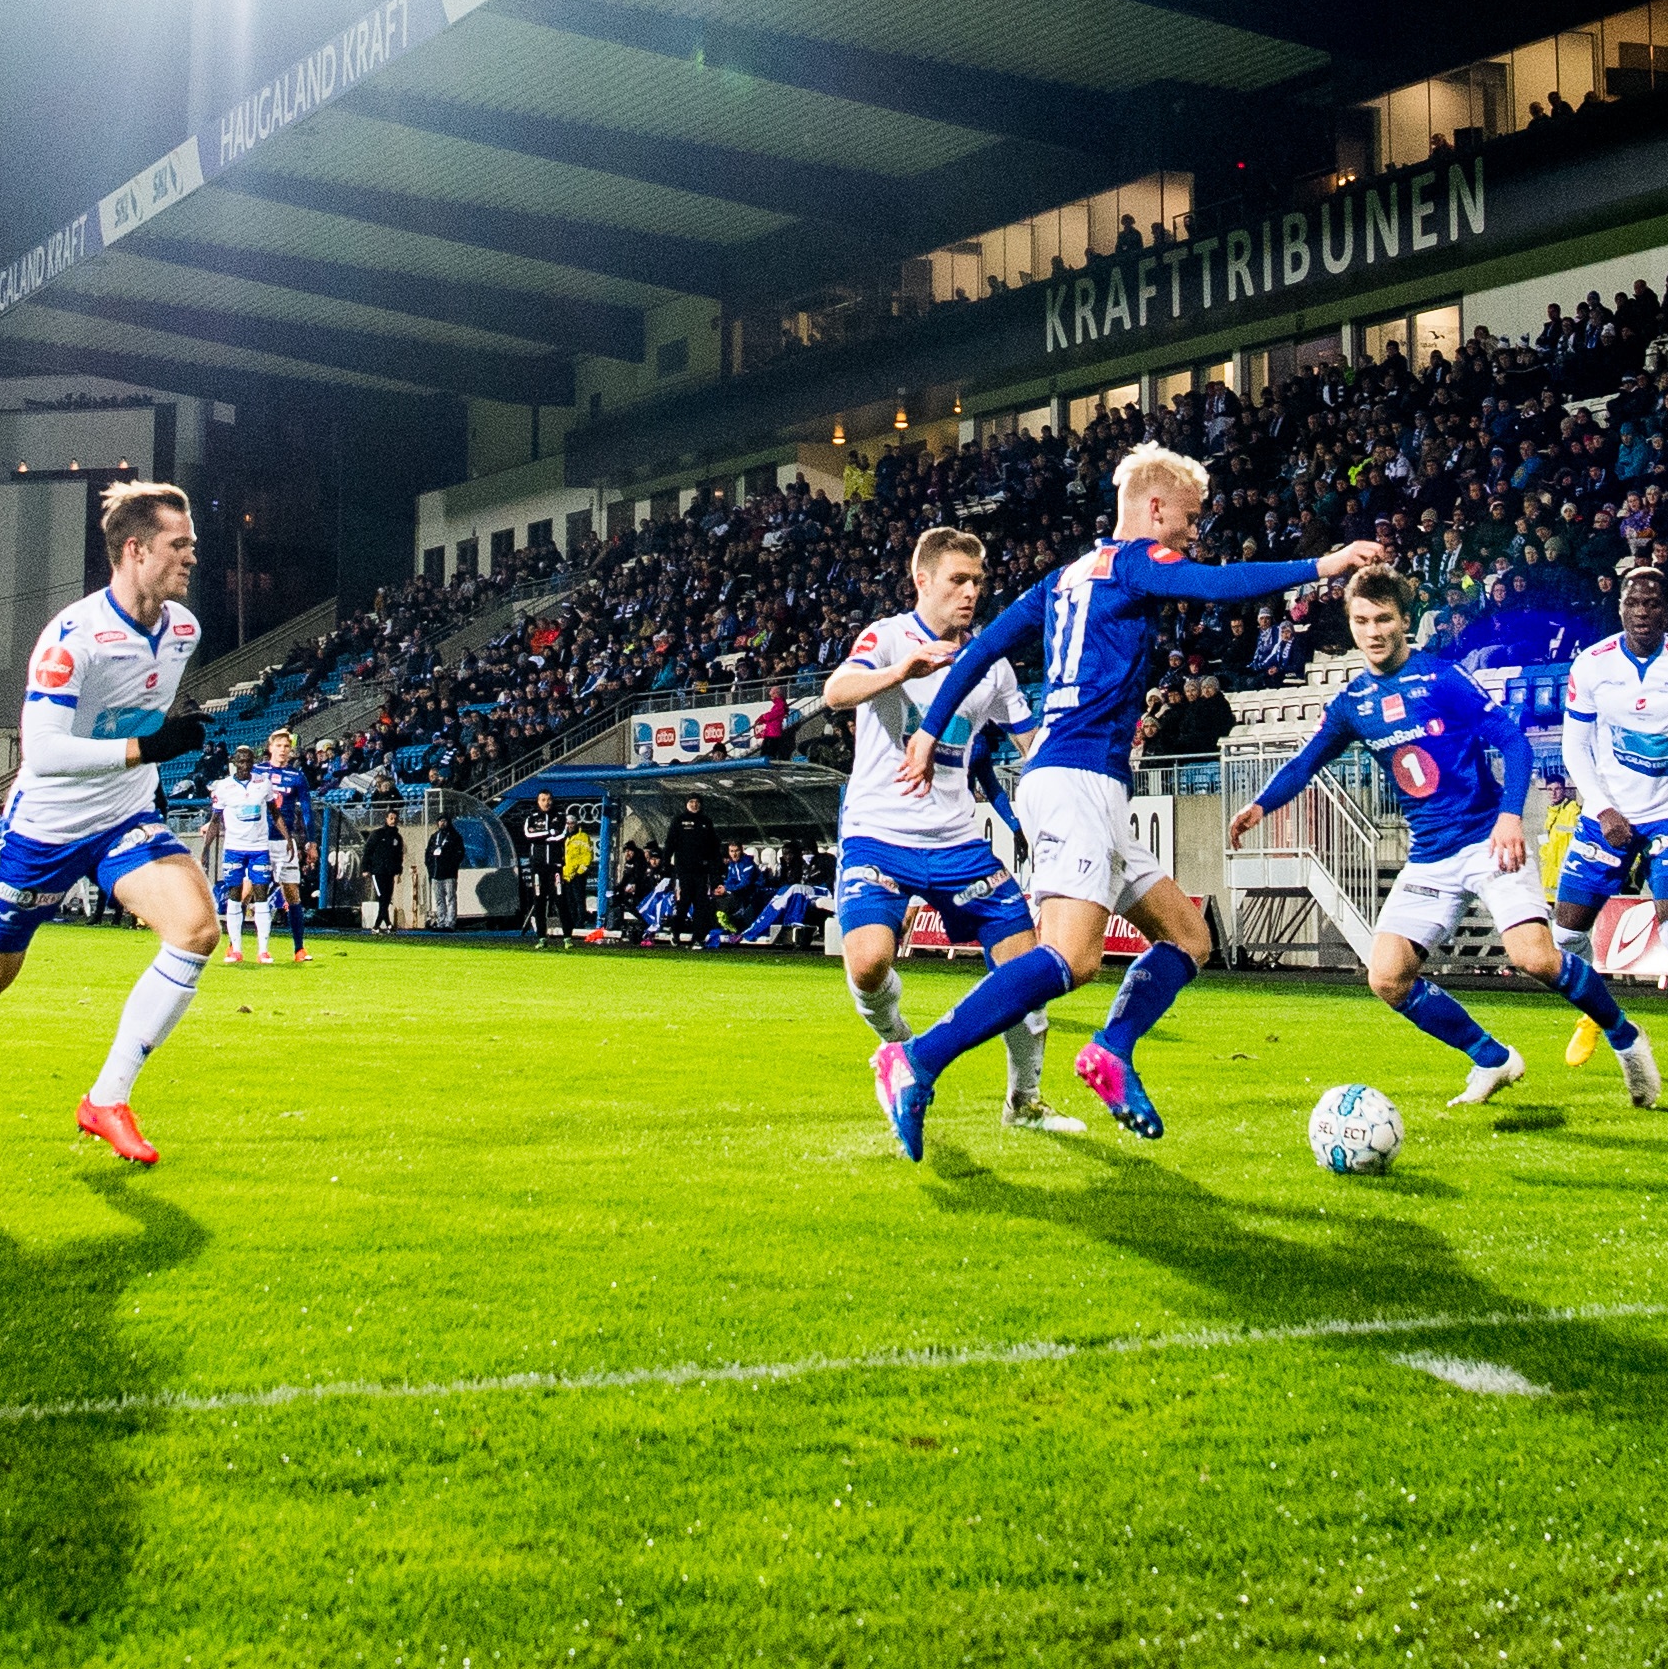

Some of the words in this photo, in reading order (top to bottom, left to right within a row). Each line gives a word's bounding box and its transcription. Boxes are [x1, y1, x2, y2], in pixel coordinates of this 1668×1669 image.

[221, 44, 336, 167] HAUGALAND
[47, 214, 87, 279] KRAFT
[1045, 156, 1485, 352] KRAFTTRIBUNEN
[1366, 725, 1428, 752] SpareBank
[1401, 753, 1426, 788] 1
[1078, 859, 1092, 874] 17
